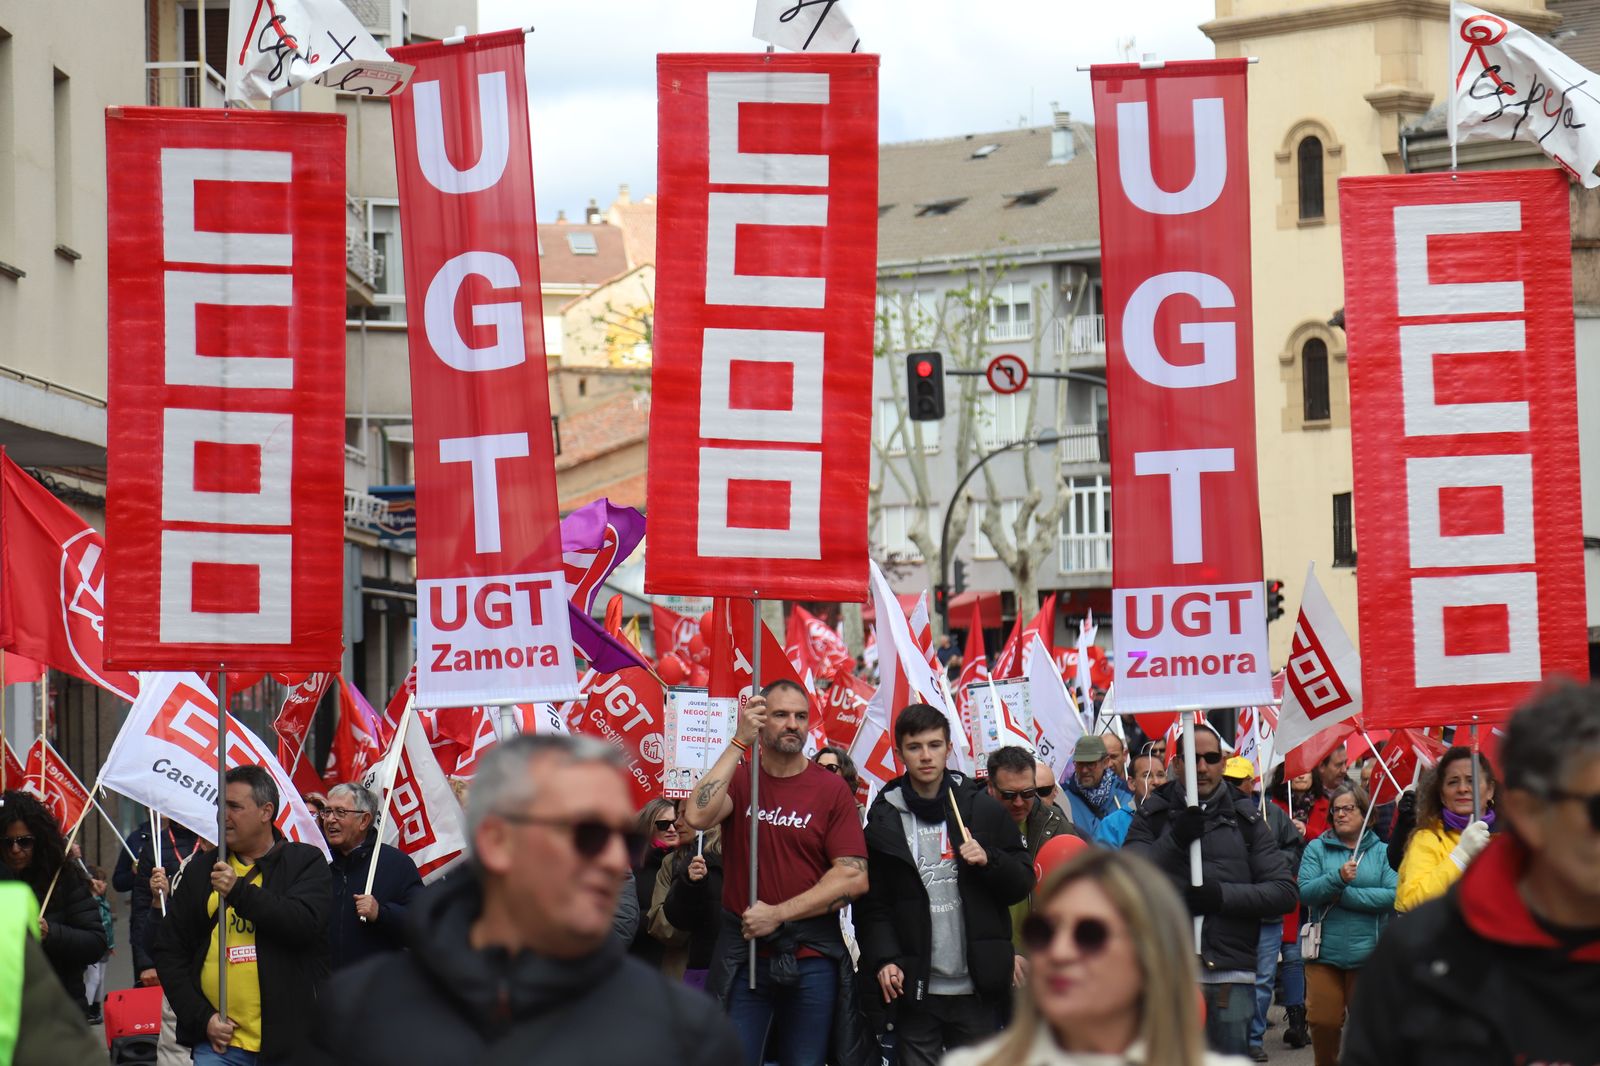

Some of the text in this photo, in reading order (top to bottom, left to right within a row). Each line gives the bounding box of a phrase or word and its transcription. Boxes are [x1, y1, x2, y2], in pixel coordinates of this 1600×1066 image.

[412, 71, 530, 555] UGT
[1115, 97, 1237, 565] UGT
[429, 579, 552, 632] UGT
[1125, 590, 1253, 639] UGT
[431, 643, 559, 672] Zamora
[1127, 651, 1256, 679] Zamora
[683, 709, 723, 717] NEGOCAR!
